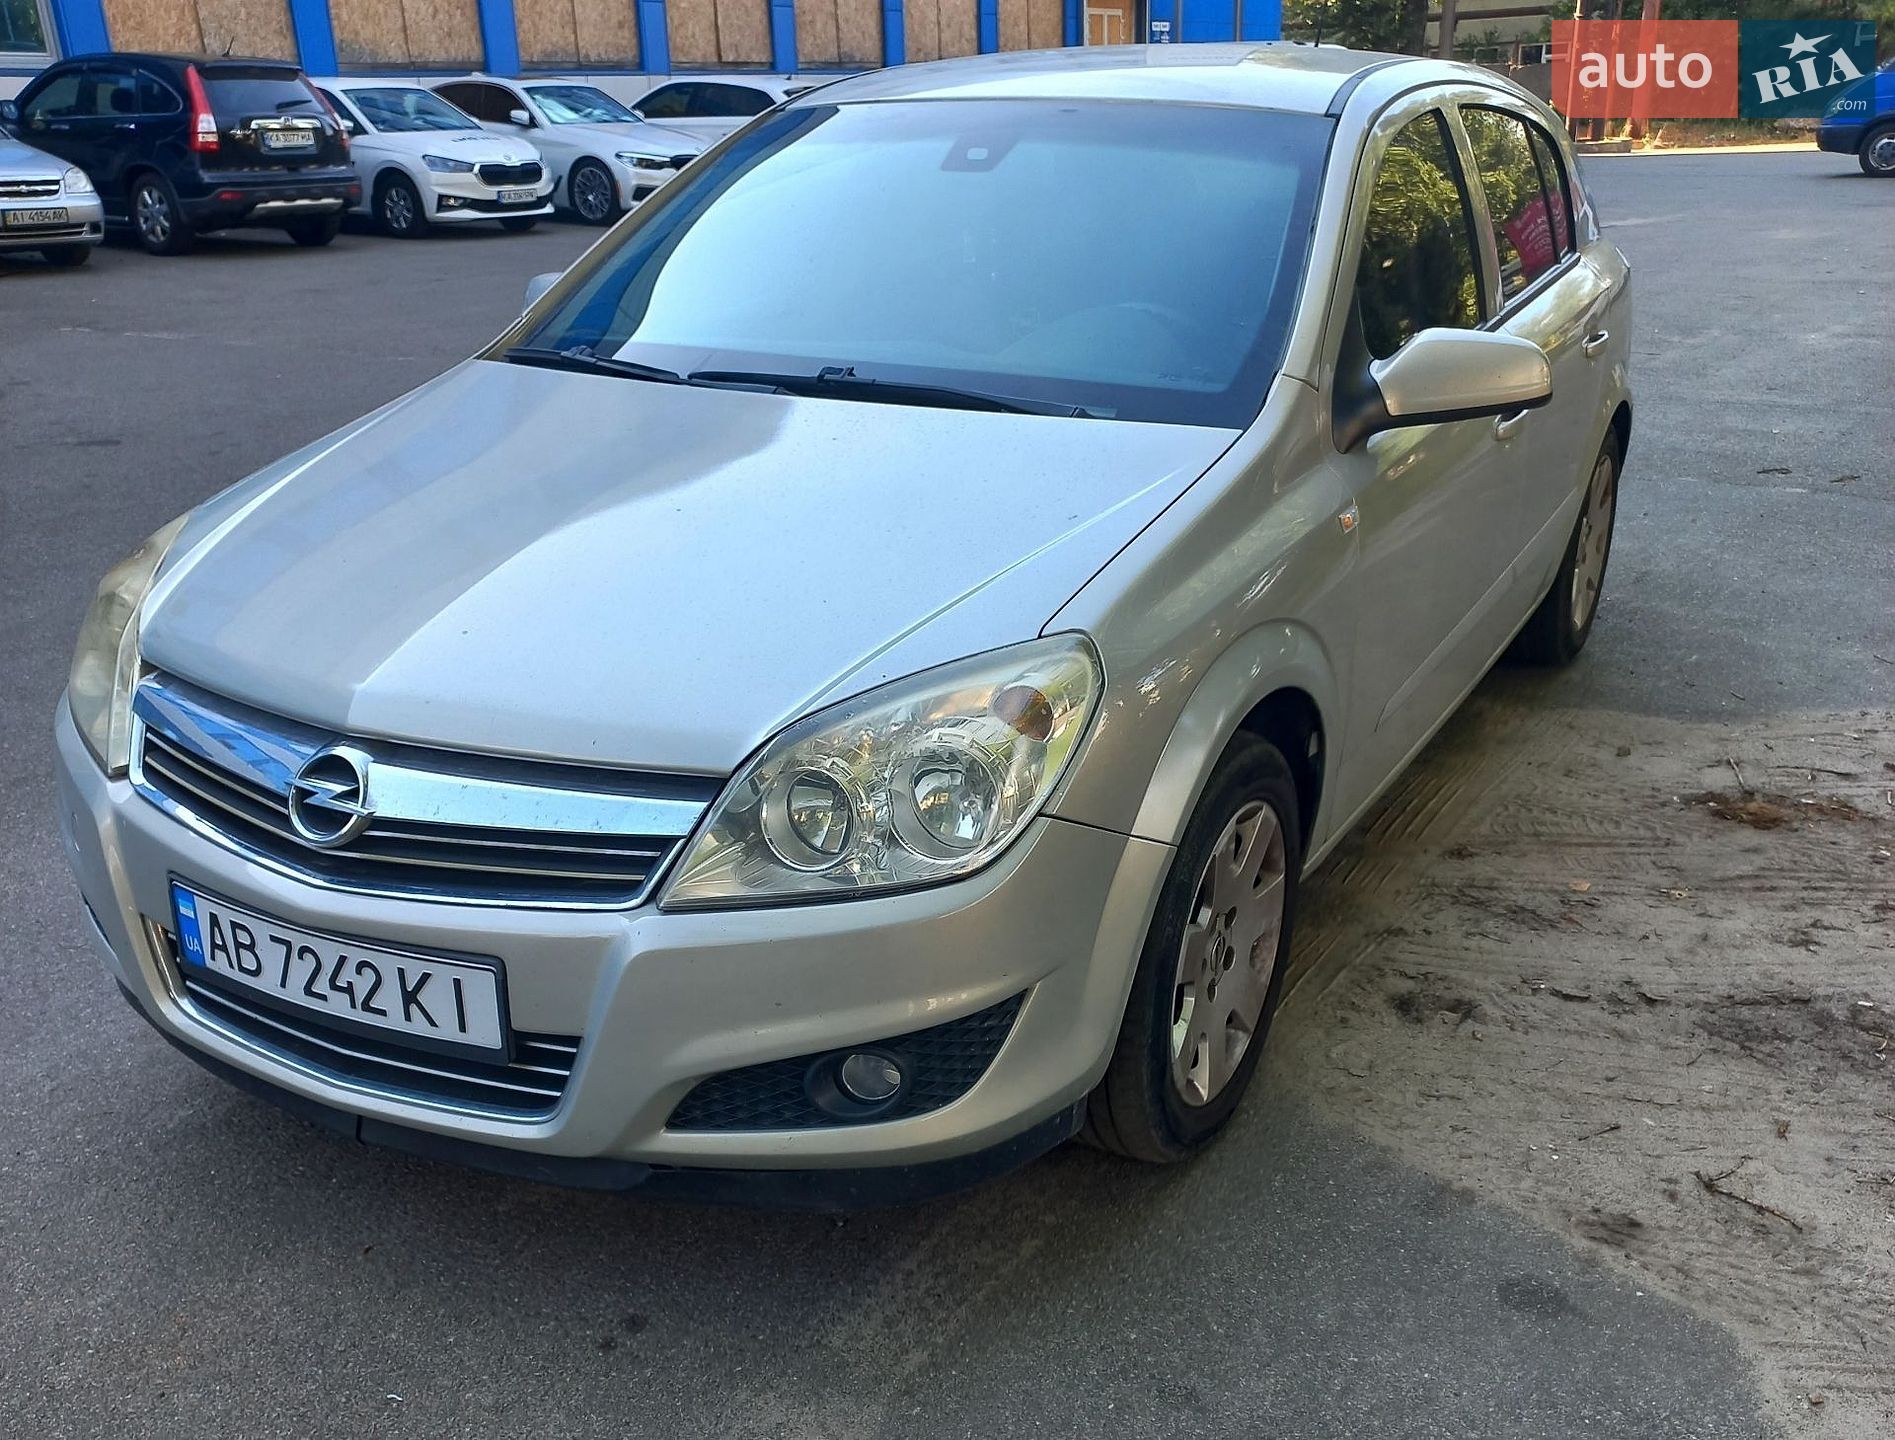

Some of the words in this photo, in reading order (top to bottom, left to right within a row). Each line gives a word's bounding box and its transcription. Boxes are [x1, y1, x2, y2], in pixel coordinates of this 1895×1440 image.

[184, 933, 203, 955] UA
[209, 911, 263, 978] AB
[269, 934, 388, 1017] 7242
[397, 966, 468, 1034] KI
